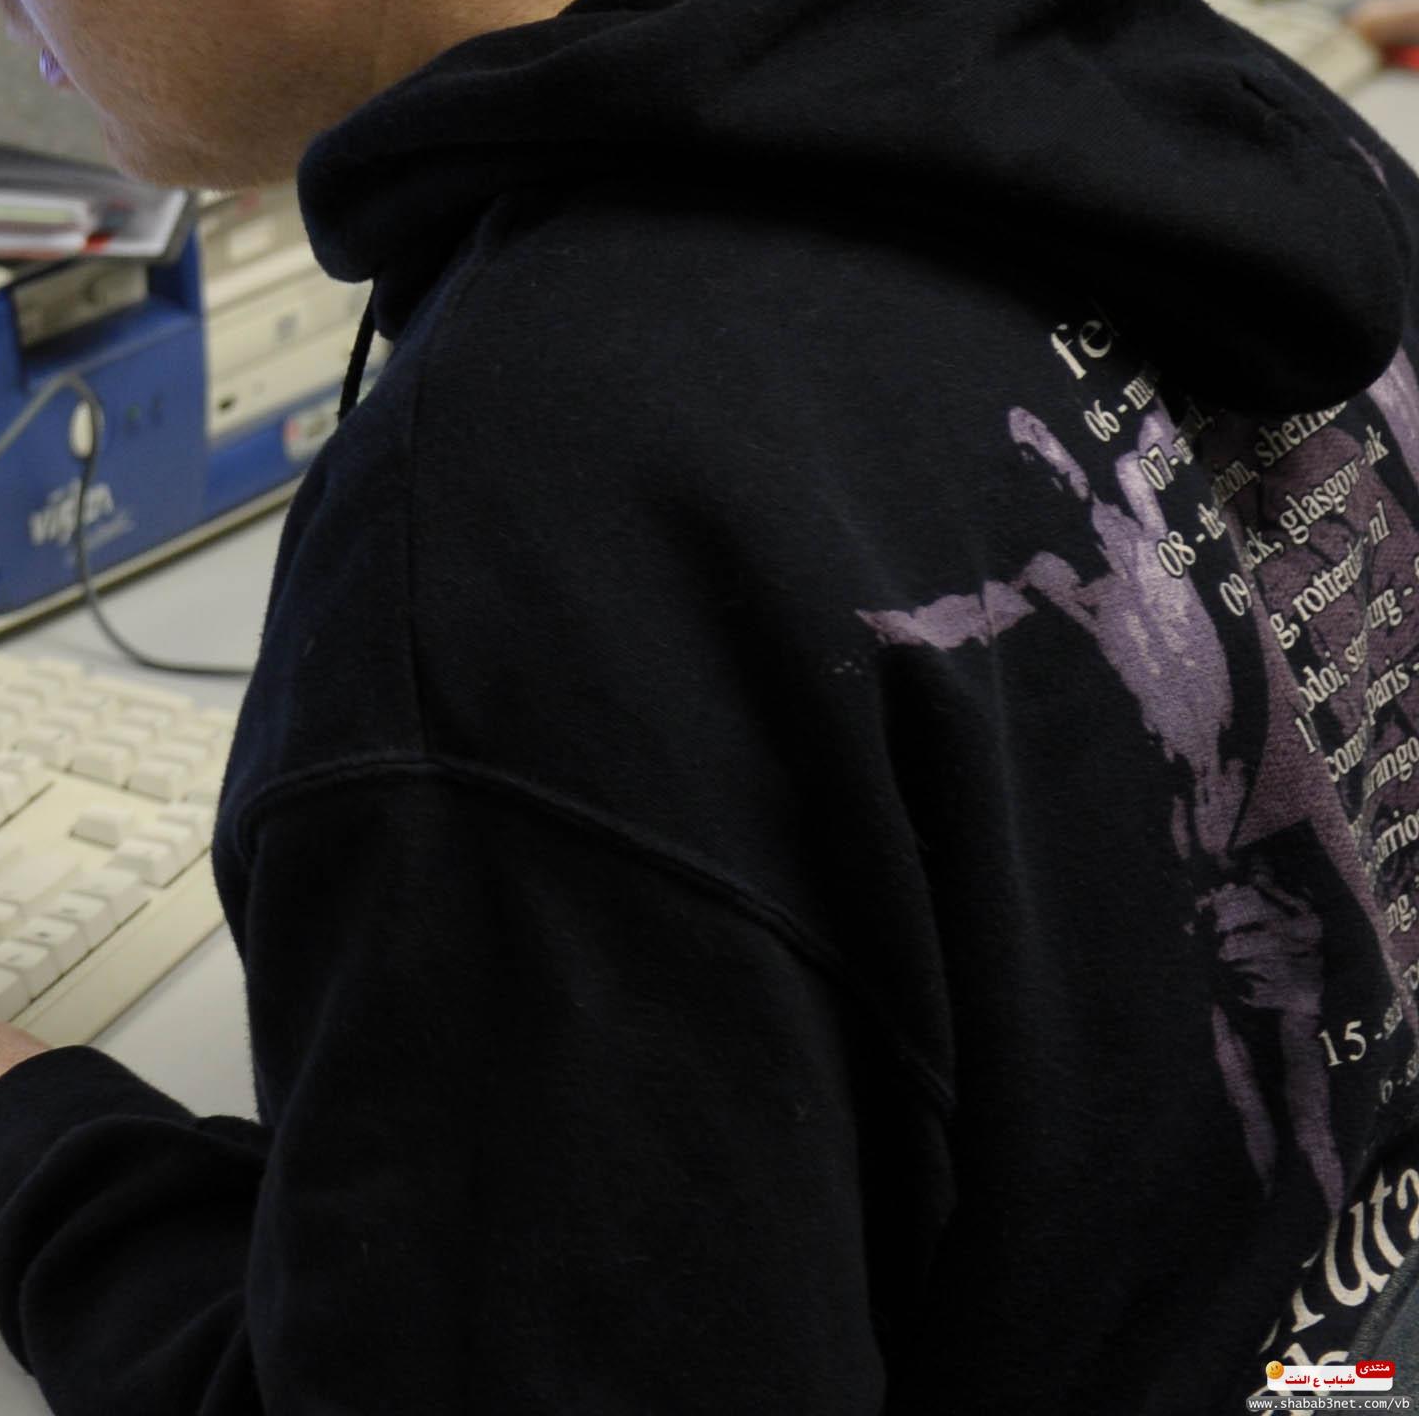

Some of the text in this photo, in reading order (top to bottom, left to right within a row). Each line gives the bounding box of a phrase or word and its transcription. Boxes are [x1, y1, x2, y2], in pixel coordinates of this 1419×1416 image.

[1083, 400, 1121, 442] 06
[1157, 530, 1197, 577] 08
[1318, 1020, 1367, 1066] 15
